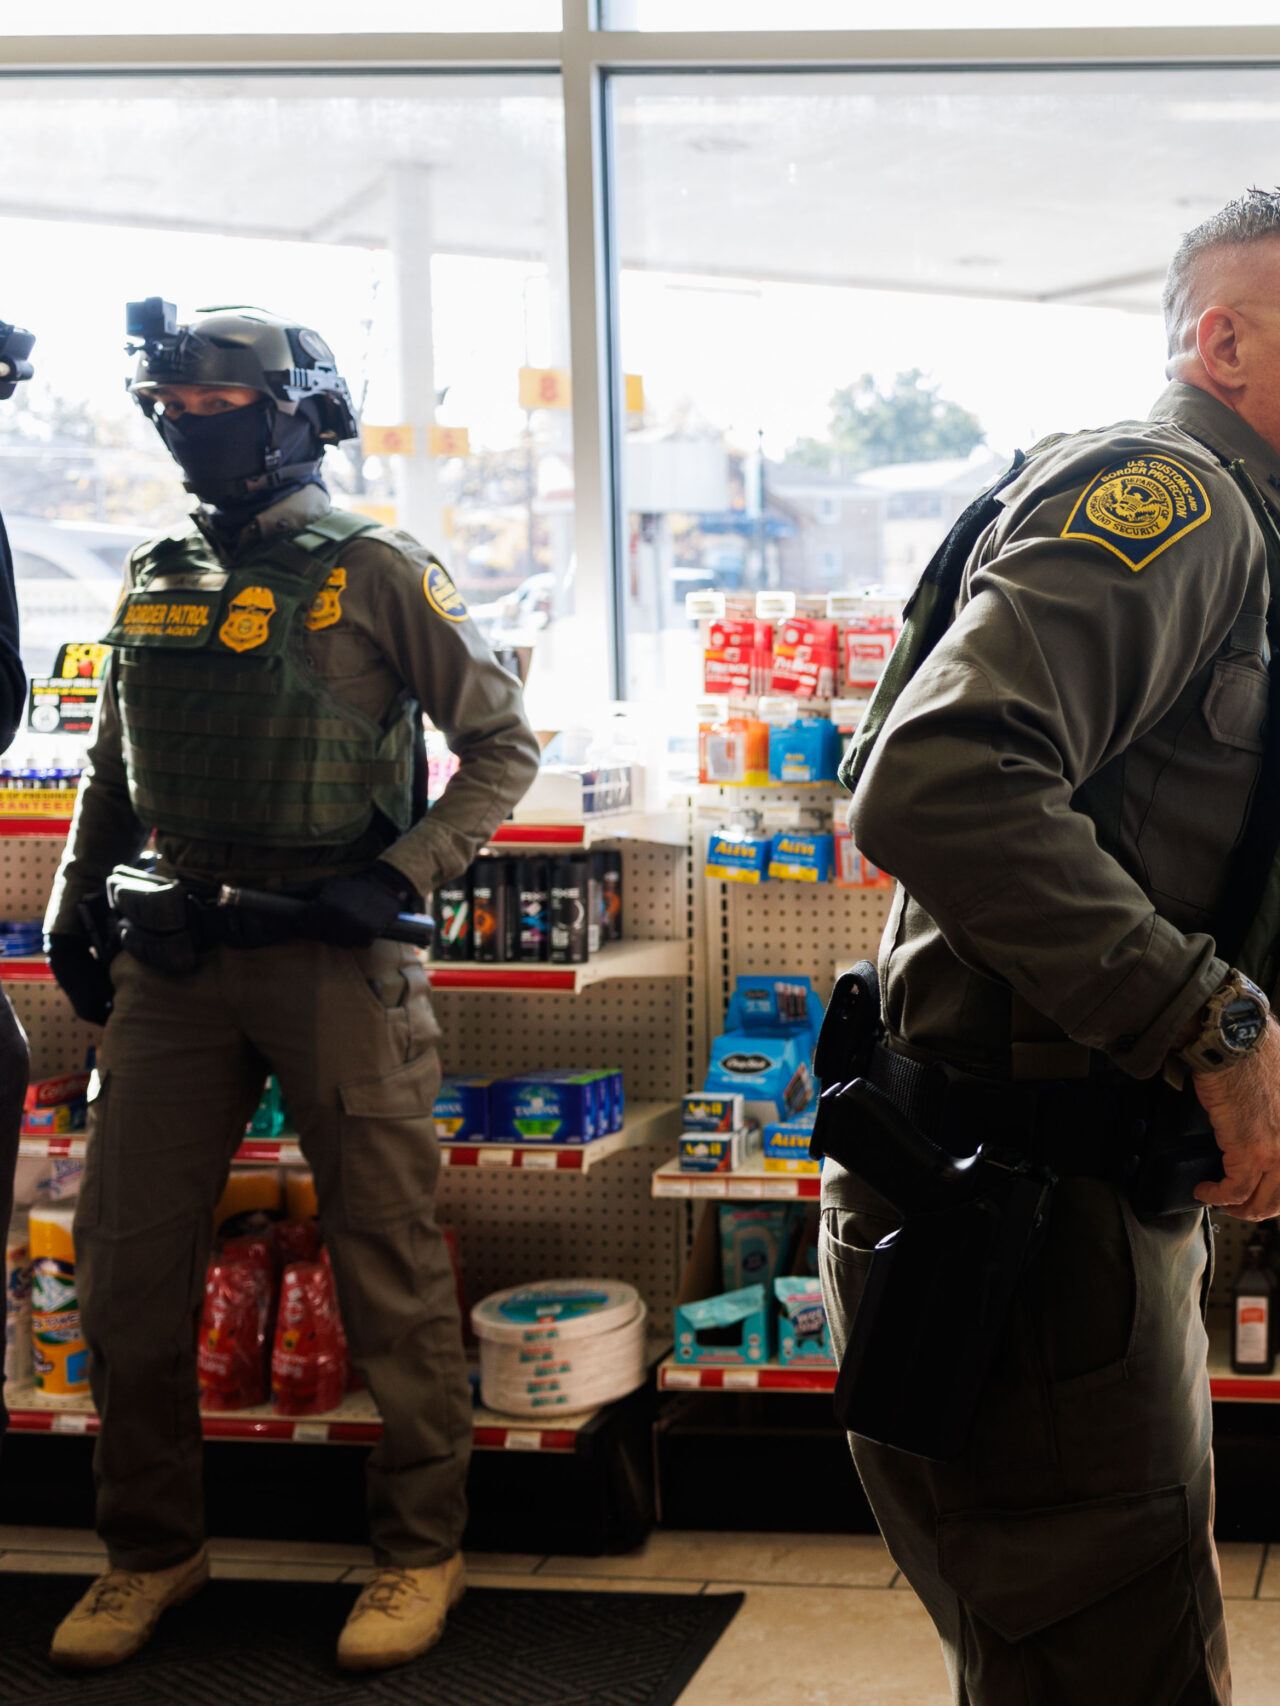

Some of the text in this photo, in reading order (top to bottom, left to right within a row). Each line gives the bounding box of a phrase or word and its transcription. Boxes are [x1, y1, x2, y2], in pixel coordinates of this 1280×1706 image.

[1100, 466, 1188, 519] BORDER PROTECTION
[1121, 477, 1169, 509] DEPARTMENT
[1127, 460, 1198, 512] U.S. CUSTOMS AND
[1089, 496, 1161, 536] HOMELAND SECURITY
[123, 604, 209, 626] BORDER PATROL
[122, 625, 200, 636] FEDERAL AGENT
[715, 841, 756, 858] ALEVE
[777, 839, 815, 855] ALEVE
[685, 1143, 722, 1155] Ail
